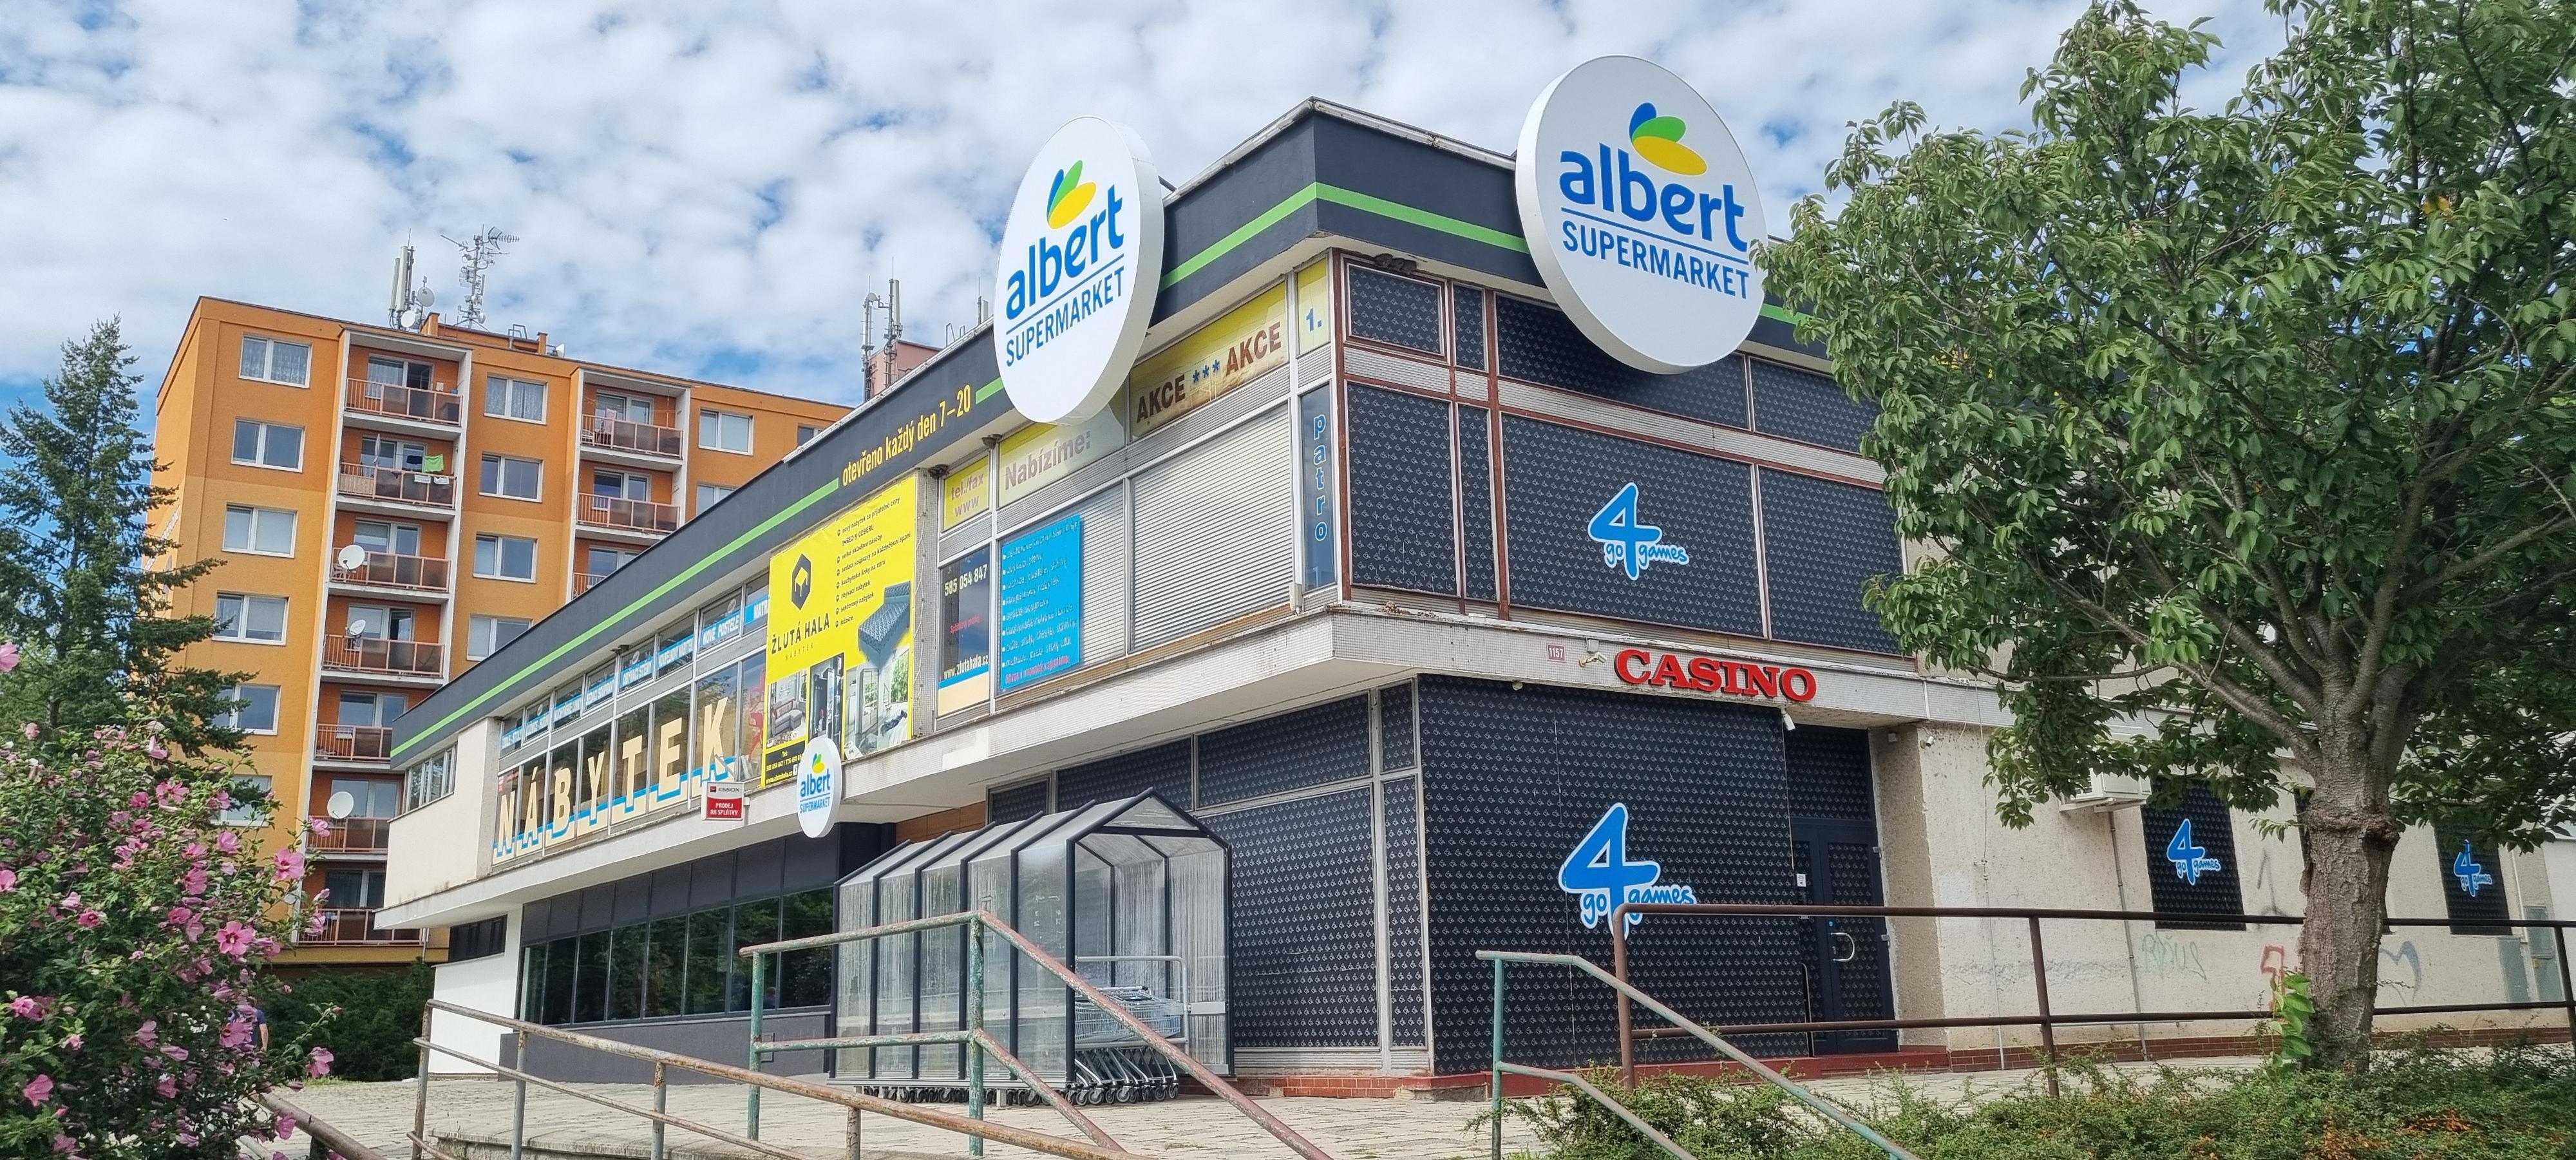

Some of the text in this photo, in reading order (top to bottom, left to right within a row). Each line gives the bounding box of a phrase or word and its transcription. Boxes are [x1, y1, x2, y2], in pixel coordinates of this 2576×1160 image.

[1559, 142, 1748, 252] albert
[1006, 184, 1124, 320] albert
[1562, 220, 1749, 299] SUPERMARKET
[1006, 266, 1124, 367] SUPERMARKET
[1306, 308, 1322, 332] 1.
[1137, 321, 1282, 423] AKCE AKCE
[842, 445, 883, 486] otevřeno
[886, 421, 914, 461] každý
[917, 412, 936, 441] den
[1005, 430, 1090, 490] Nabízíme:
[1314, 414, 1327, 541] patro
[951, 473, 983, 500] tel./fax
[954, 496, 980, 517] www
[1588, 482, 1689, 580] go 4 games
[944, 578, 958, 596] 585
[959, 571, 972, 589] 054
[974, 564, 987, 583] 847
[772, 613, 830, 654] ŽLUTÁ HALA
[1548, 647, 1564, 659] 1157
[943, 654, 989, 680] www.zlutahala.cz
[1615, 648, 1817, 701] CASINO
[498, 697, 735, 852] NÁBYTEK
[800, 768, 830, 797] albert
[800, 797, 830, 813] SUPERMARKET
[1560, 803, 1660, 940] 4
[2166, 819, 2221, 885] go 4 games
[1581, 891, 1606, 927] go
